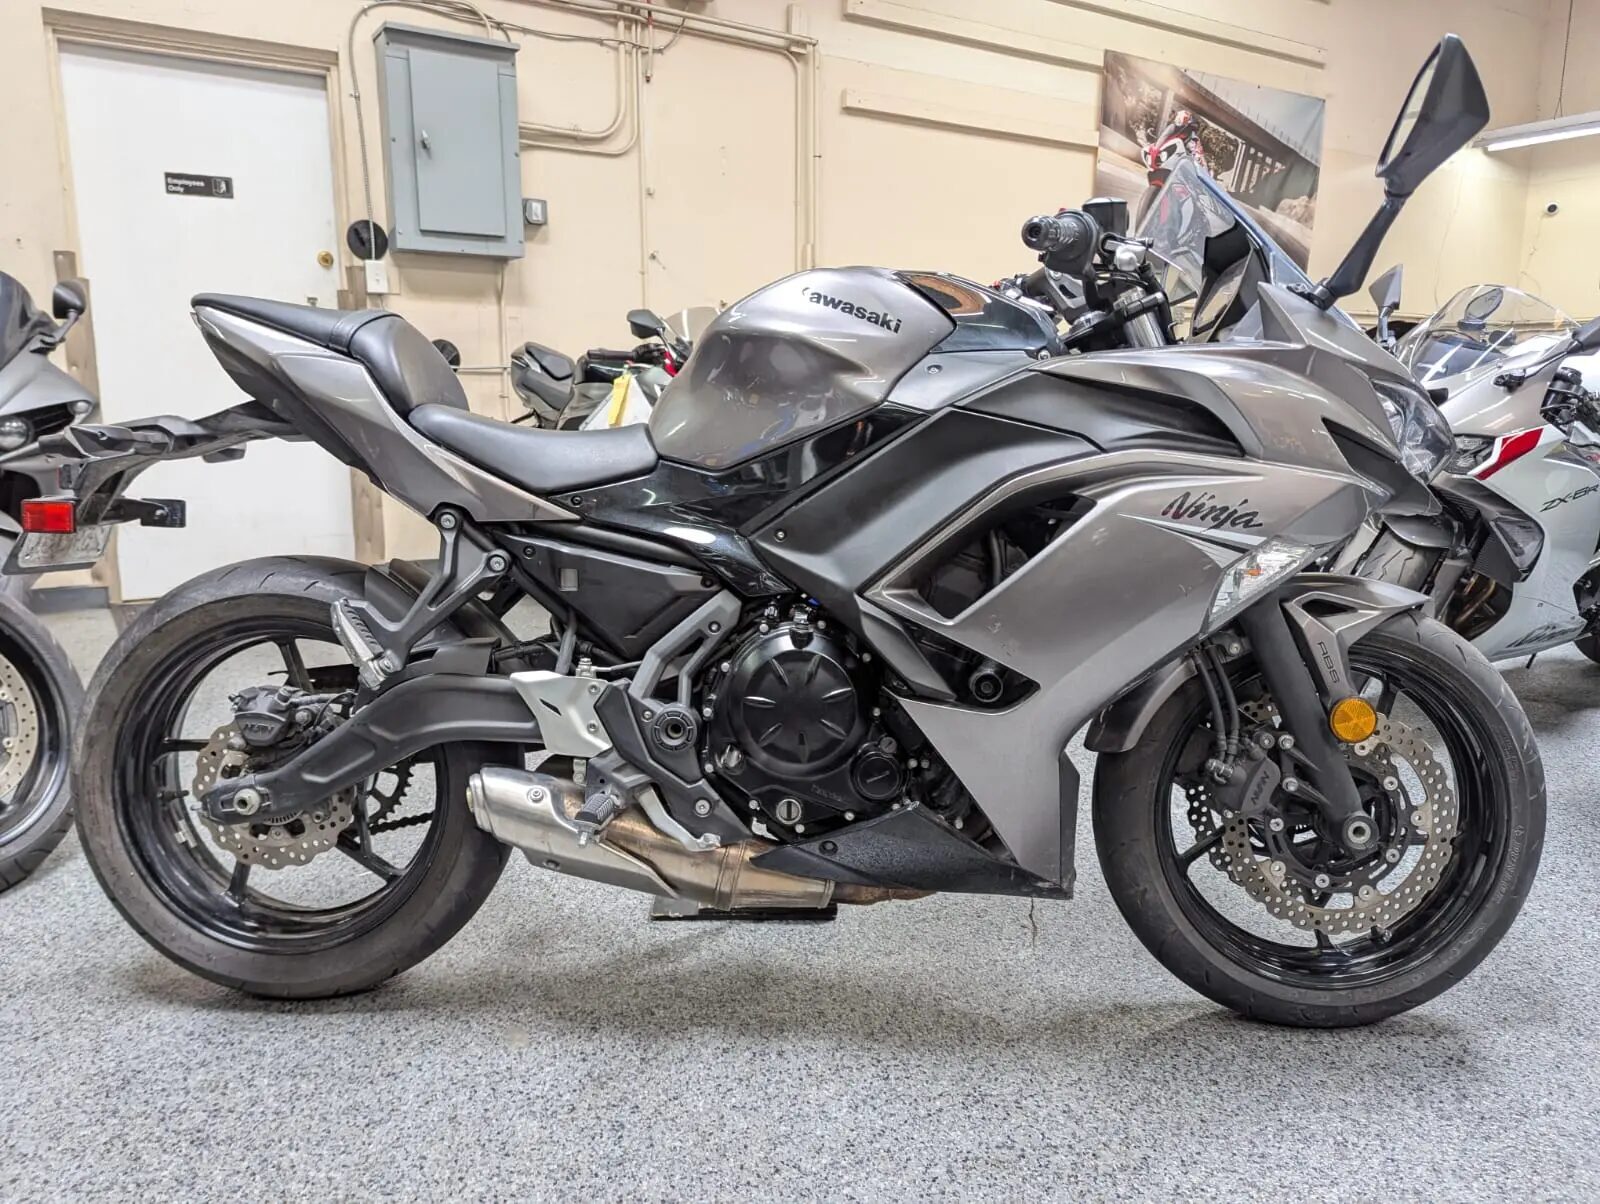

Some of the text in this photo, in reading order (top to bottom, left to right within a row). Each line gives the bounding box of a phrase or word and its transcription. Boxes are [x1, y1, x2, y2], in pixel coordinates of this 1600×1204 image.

[167, 177, 205, 187] Employees
[167, 185, 185, 193] Only
[802, 287, 902, 334] awasaki
[1161, 491, 1263, 532] Ninja
[1317, 641, 1340, 683] ABS
